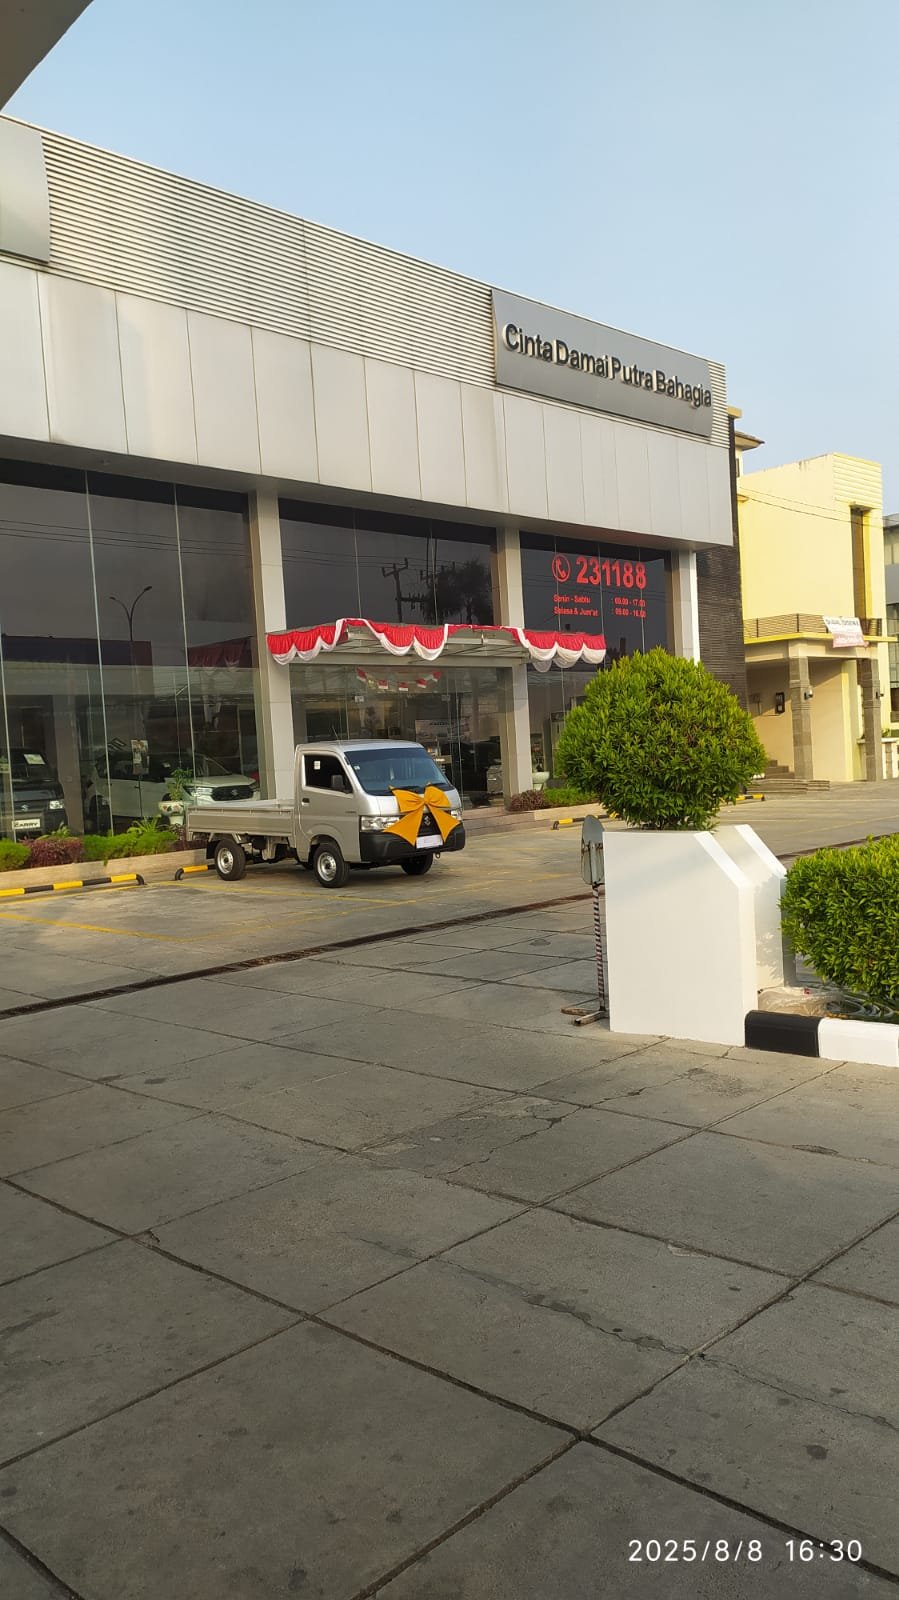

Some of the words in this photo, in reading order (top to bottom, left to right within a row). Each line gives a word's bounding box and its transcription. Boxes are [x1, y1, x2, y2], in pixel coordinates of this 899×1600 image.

[502, 323, 553, 362] Cinta
[554, 339, 609, 379] Damai
[609, 355, 653, 391] Putra
[653, 369, 712, 409] Bahagia
[576, 556, 647, 590] 231188
